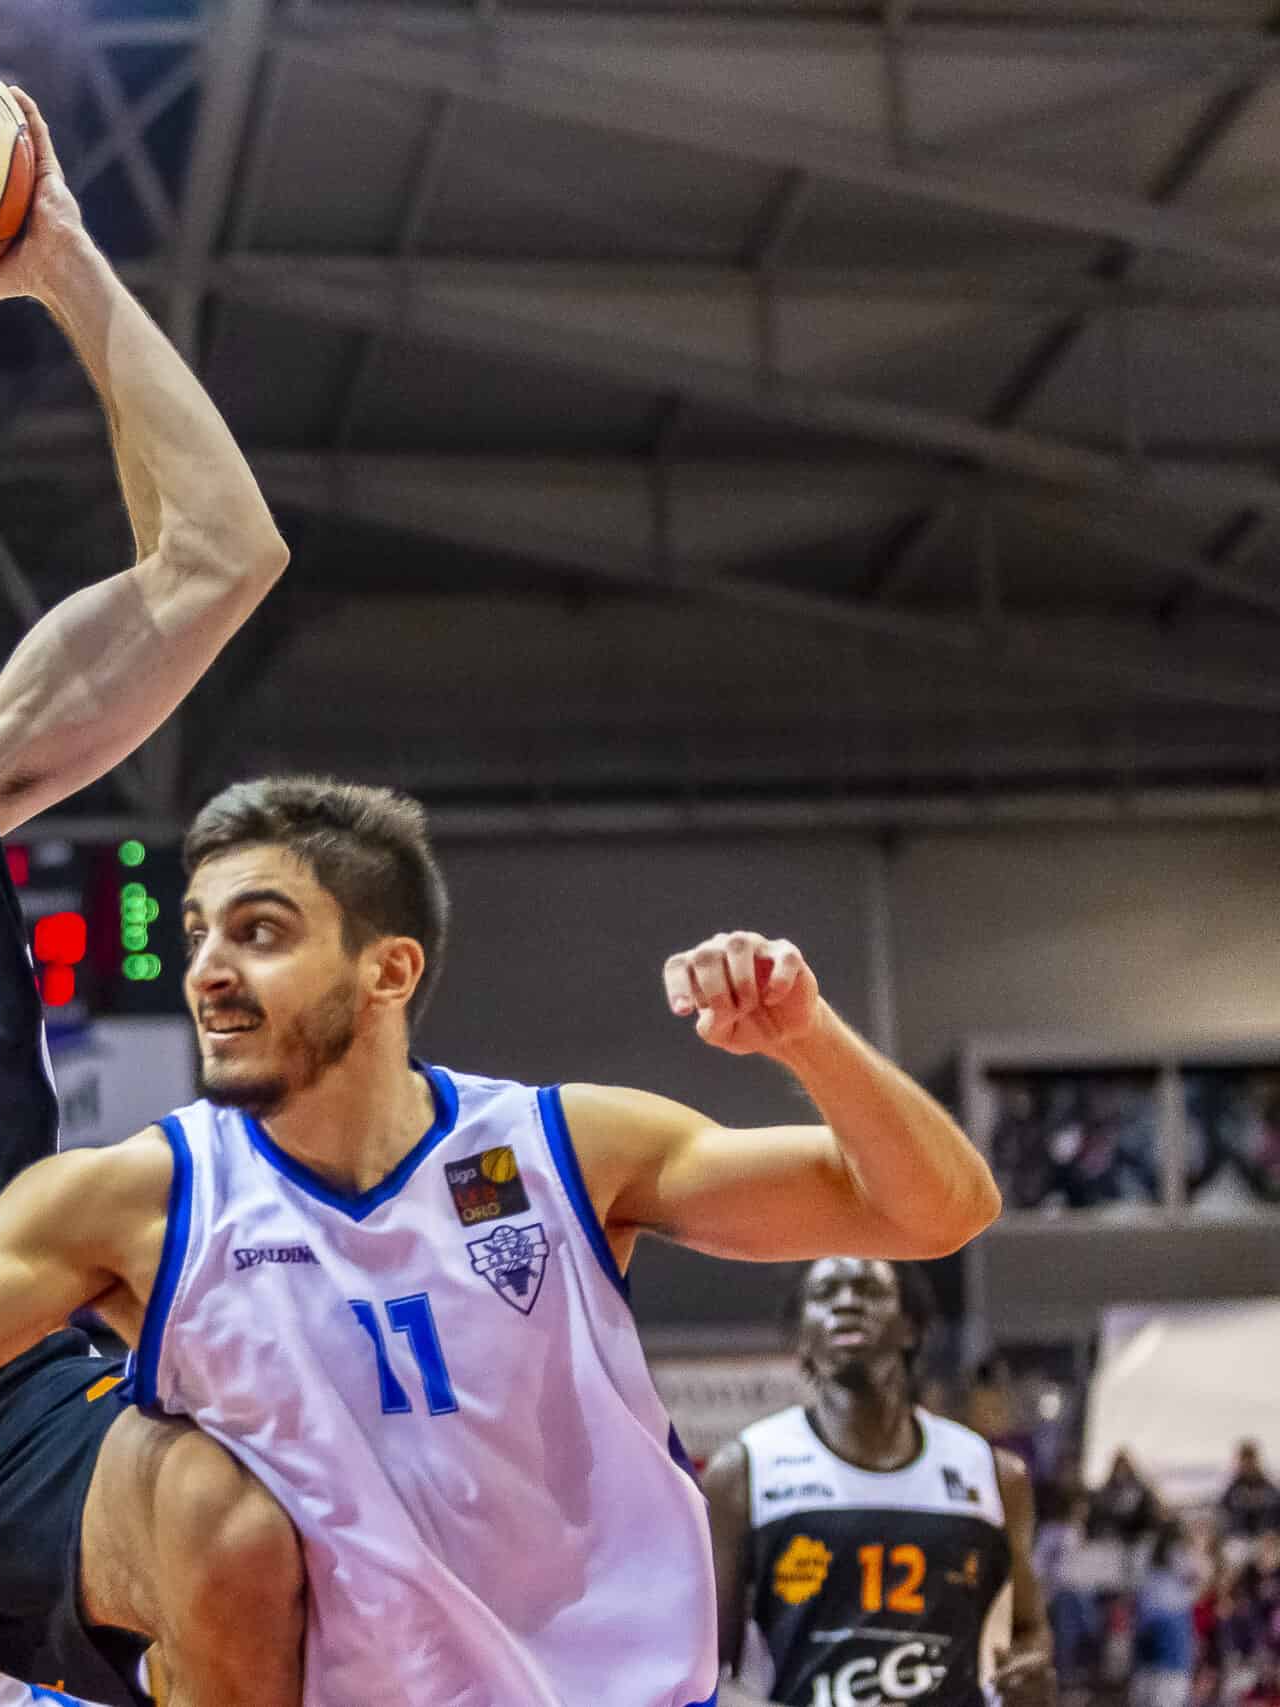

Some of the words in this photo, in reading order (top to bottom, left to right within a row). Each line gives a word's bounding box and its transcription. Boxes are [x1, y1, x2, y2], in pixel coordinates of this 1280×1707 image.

[233, 1245, 321, 1271] SPALDIN
[349, 1292, 460, 1417] 11
[858, 1544, 927, 1615] 12
